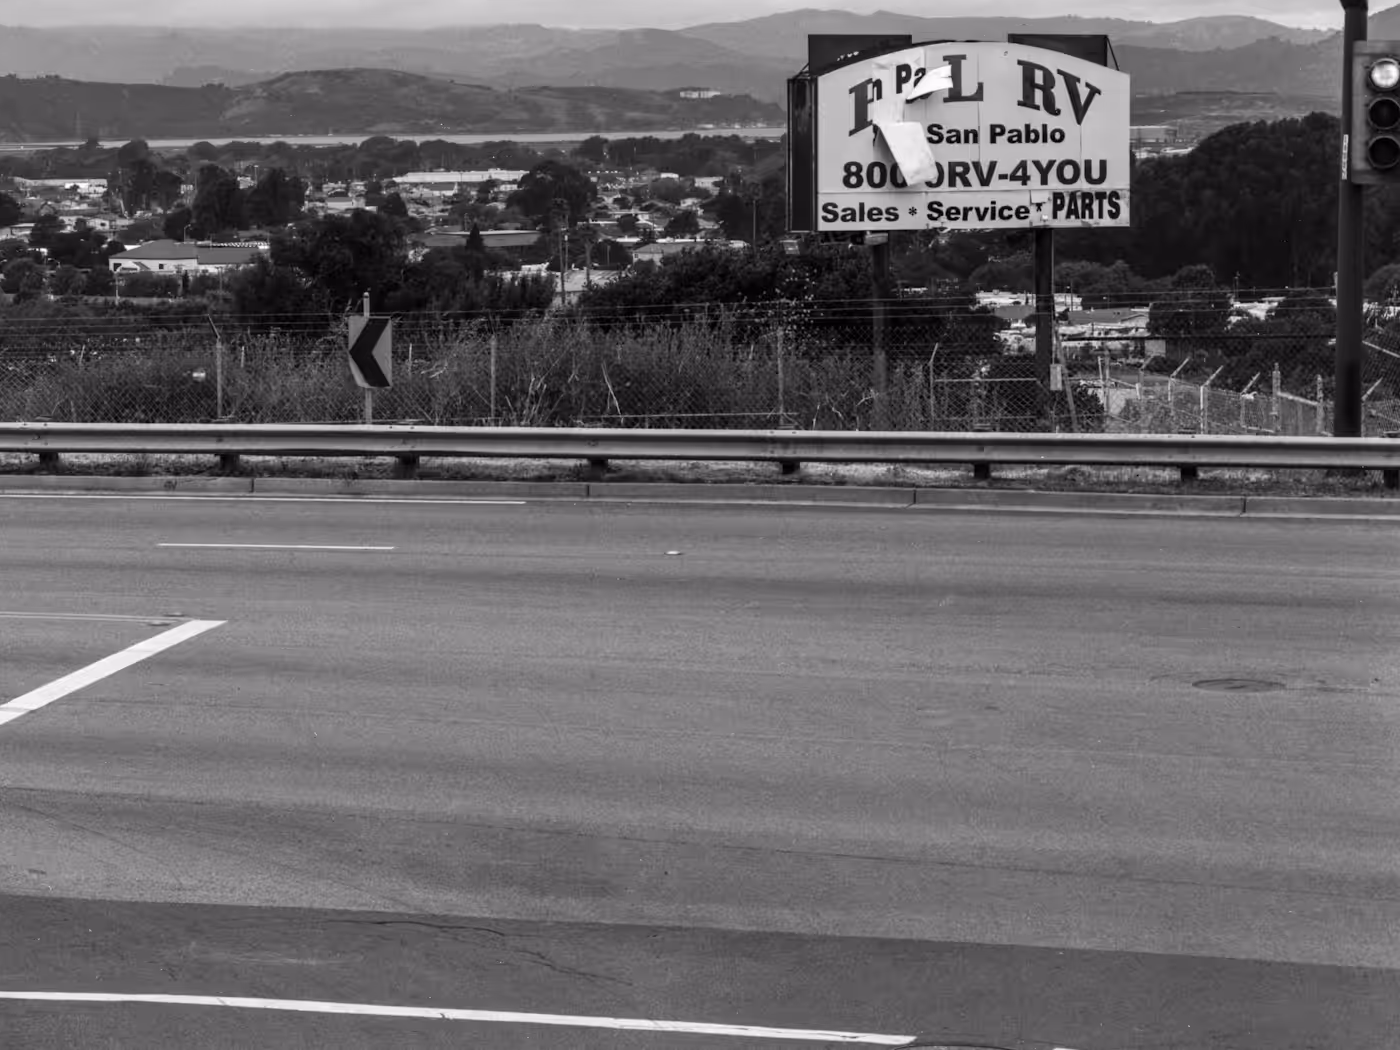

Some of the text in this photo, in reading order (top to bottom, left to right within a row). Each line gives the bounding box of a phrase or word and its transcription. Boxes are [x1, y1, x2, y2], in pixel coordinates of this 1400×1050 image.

[1017, 59, 1102, 126] RV
[927, 123, 1066, 144] San Pablo
[821, 190, 1121, 223] Sales Service PARTS
